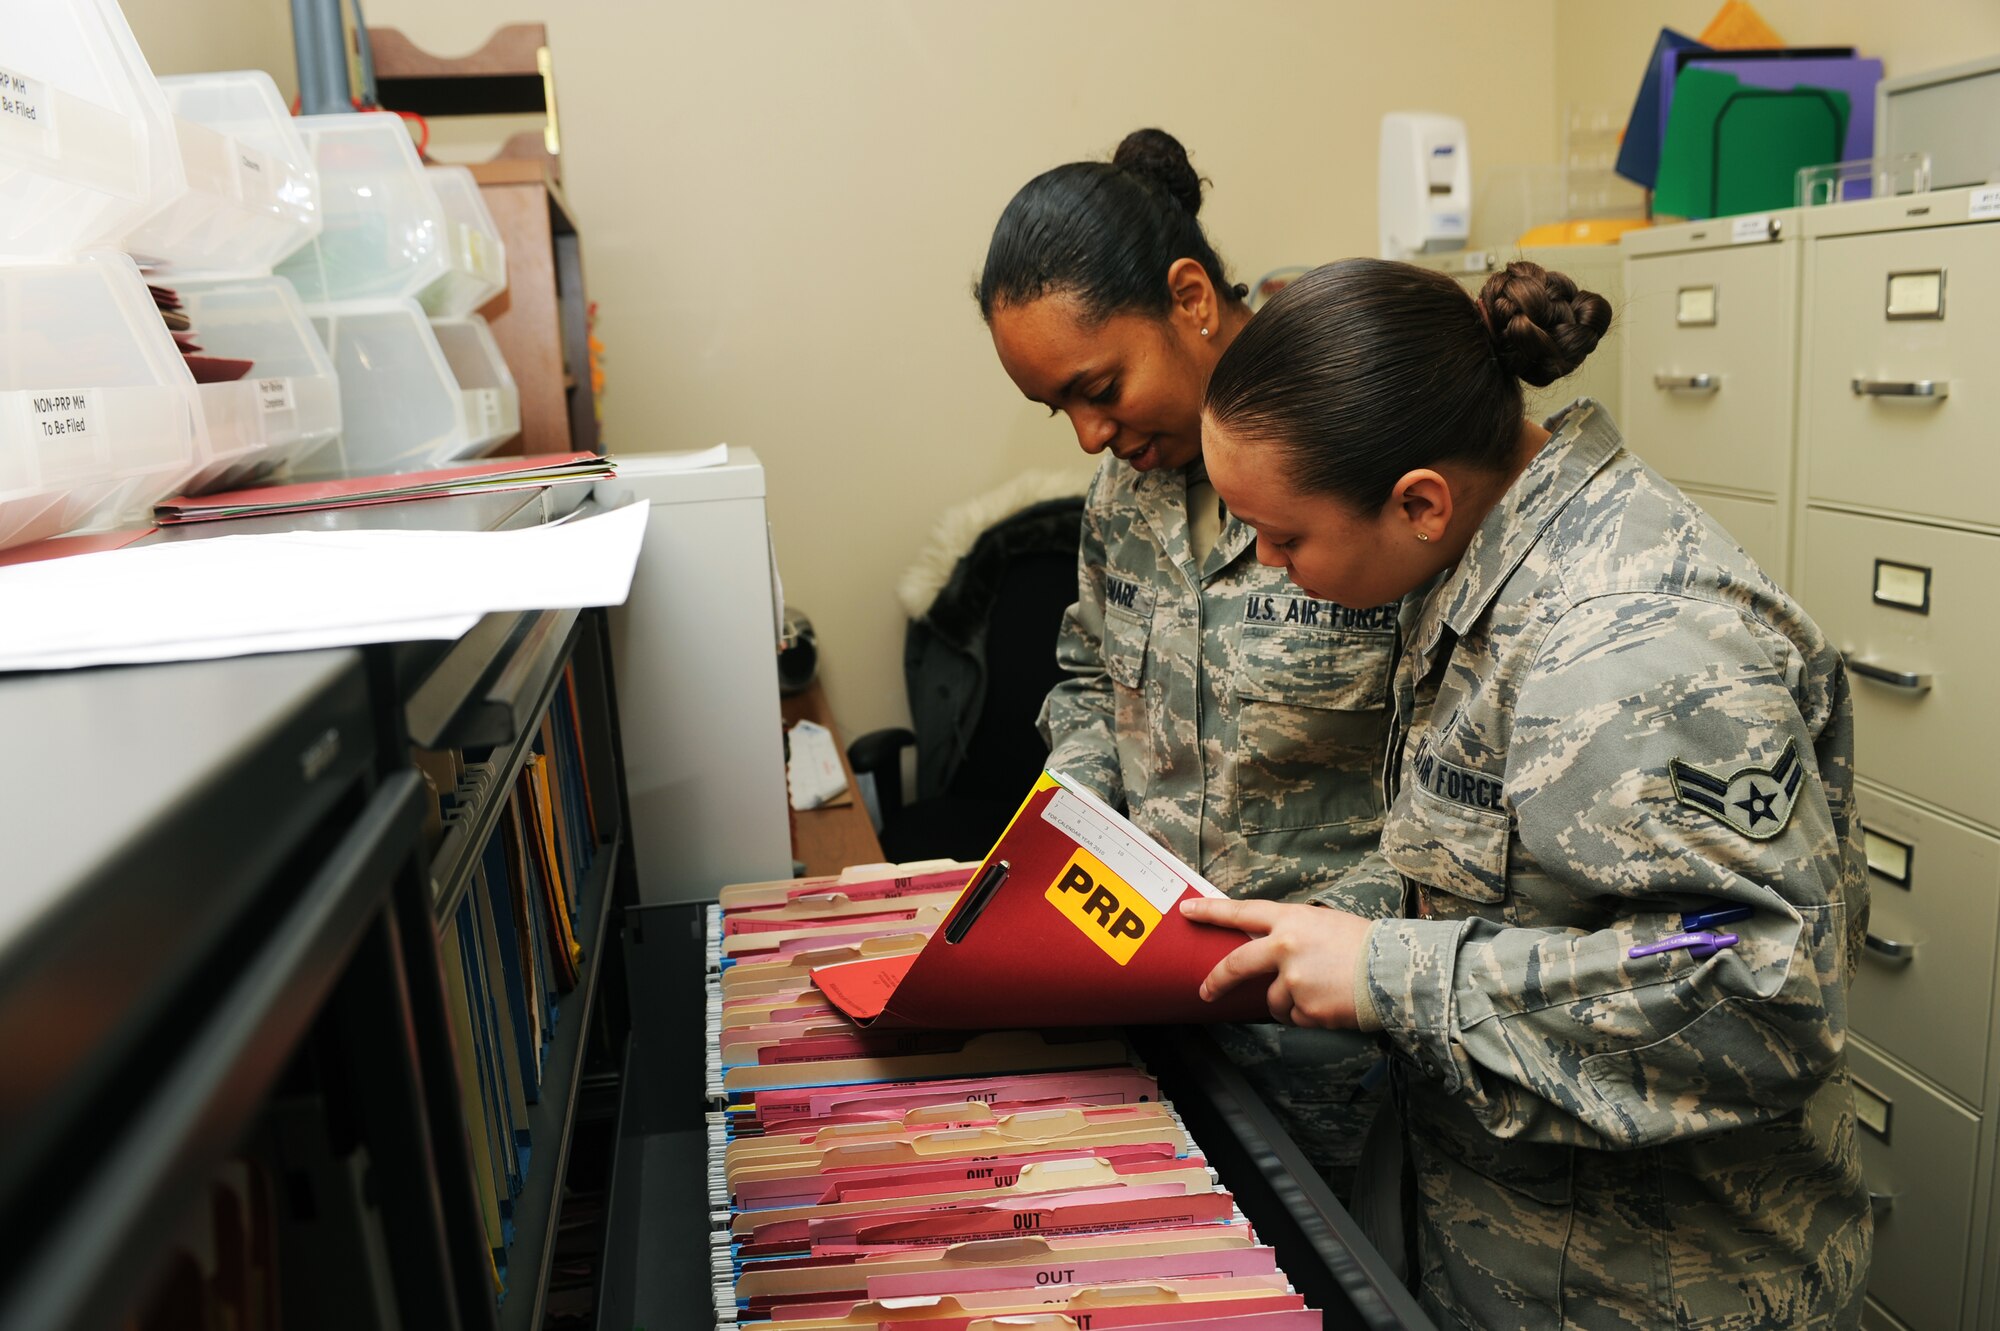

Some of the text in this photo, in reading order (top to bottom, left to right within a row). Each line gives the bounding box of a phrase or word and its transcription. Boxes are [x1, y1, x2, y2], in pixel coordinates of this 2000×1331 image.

[12, 76, 26, 95] MH
[2, 95, 36, 120] Be Filed
[33, 395, 86, 413] NON-PRP MH
[42, 417, 85, 436] To Be Filed
[1246, 597, 1396, 630] U.S. AIR FORCE
[1436, 763, 1505, 812] FORCE
[1047, 812, 1106, 856] FOR CALENDAR YEAR 2010
[895, 876, 912, 889] OUT
[1057, 862, 1146, 940] PRP
[1013, 1212, 1042, 1229] OUT
[1036, 1269, 1075, 1285] OUT
